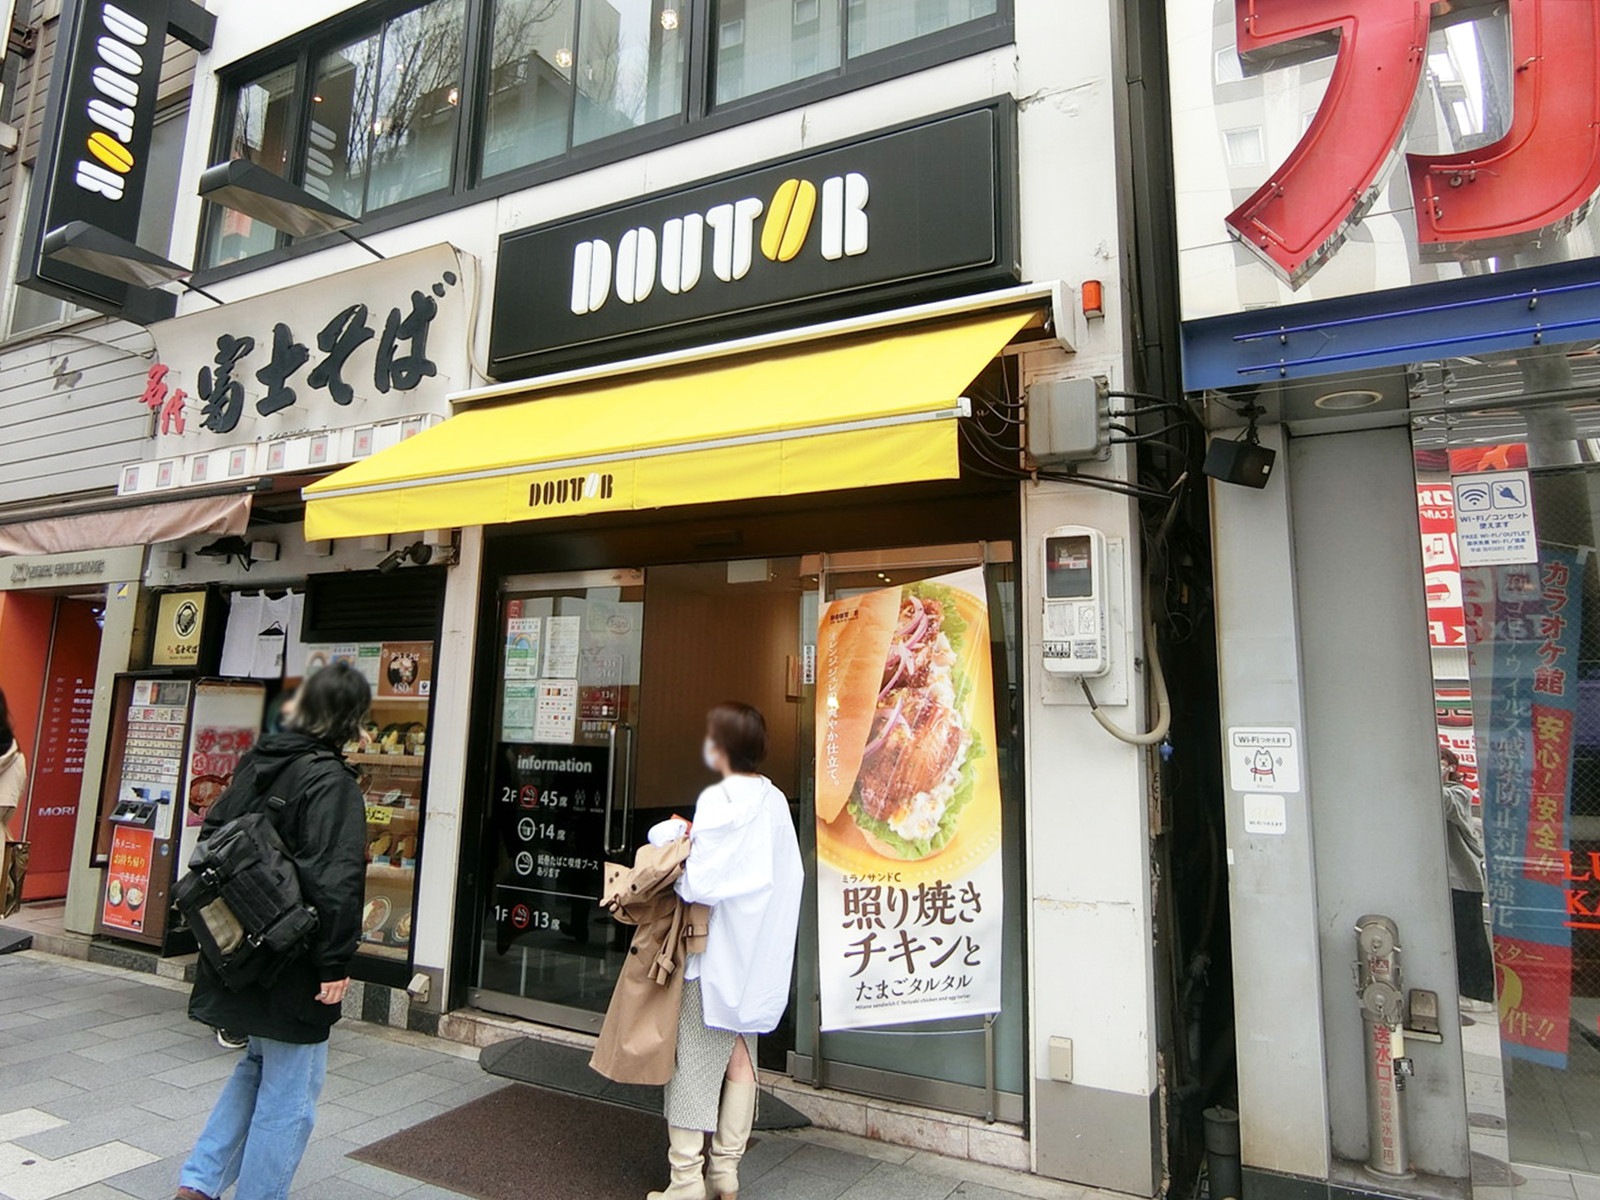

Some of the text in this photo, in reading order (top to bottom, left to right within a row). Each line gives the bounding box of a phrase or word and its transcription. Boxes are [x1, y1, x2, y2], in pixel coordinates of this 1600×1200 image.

[75, 3, 150, 202] DOUTOR
[571, 171, 869, 316] DOUTOR
[139, 270, 457, 435] 名代 富士そば
[528, 472, 613, 508] DOUTOR
[830, 609, 859, 621] DOUTR
[1532, 561, 1570, 697] カラオケ館
[517, 755, 592, 773] information
[501, 787, 518, 802] 2F
[494, 904, 509, 922] 1F
[842, 879, 982, 931] 照り焼き
[843, 929, 981, 978] チキンと
[855, 974, 973, 1002] たまごタルタル
[1371, 1025, 1392, 1081] 送水口
